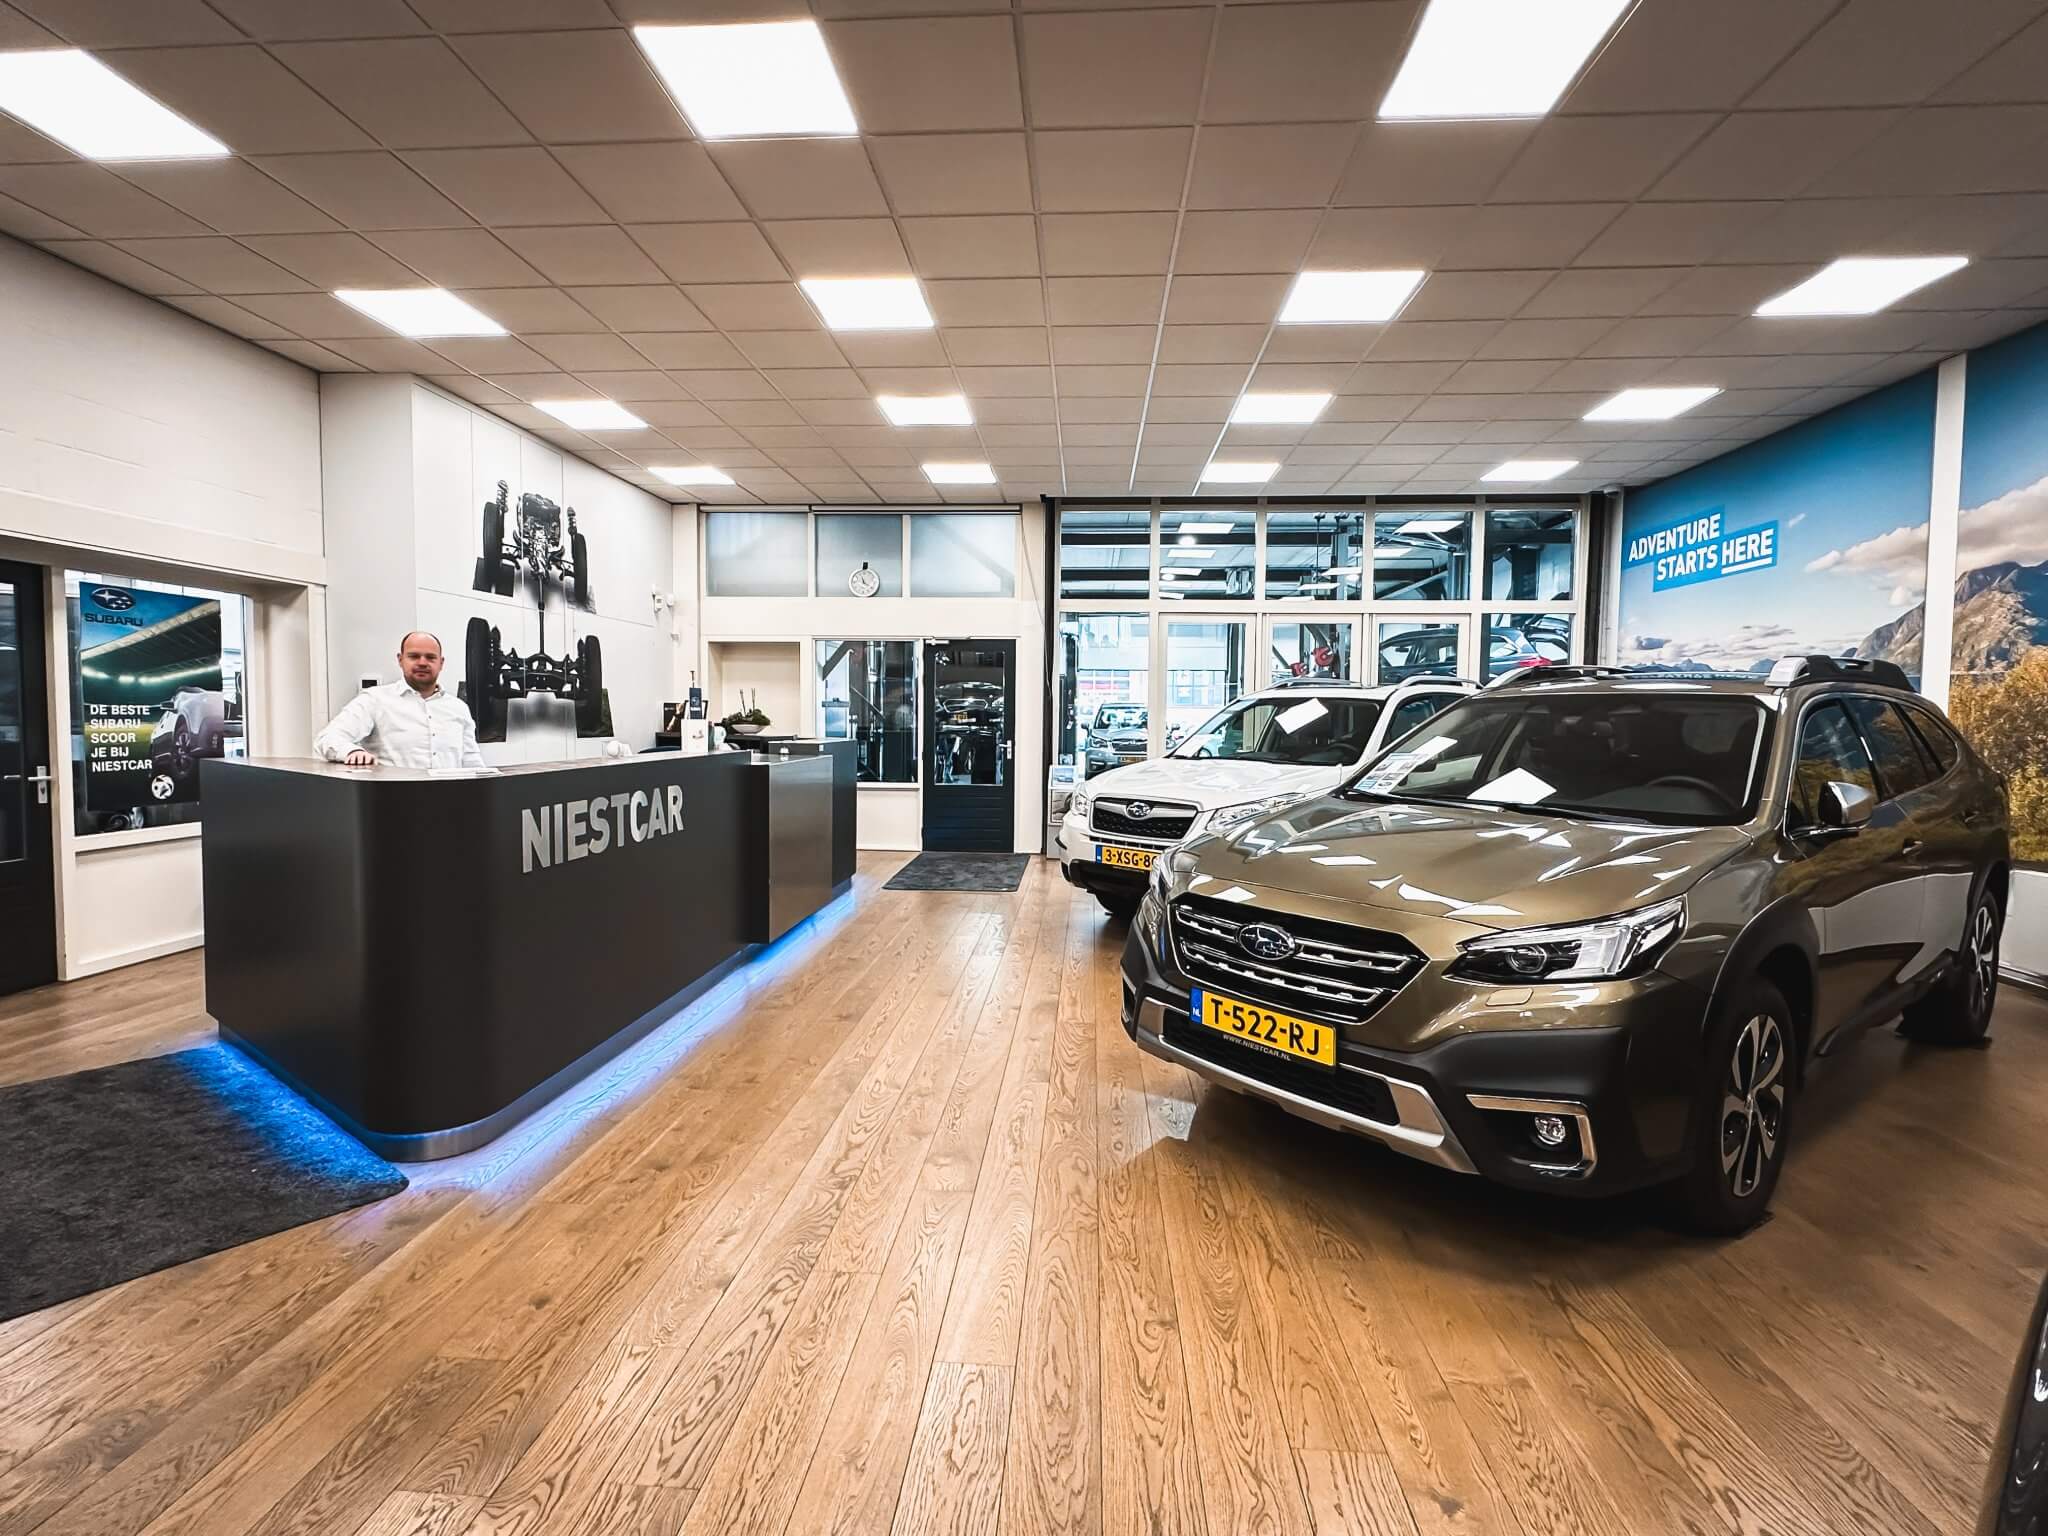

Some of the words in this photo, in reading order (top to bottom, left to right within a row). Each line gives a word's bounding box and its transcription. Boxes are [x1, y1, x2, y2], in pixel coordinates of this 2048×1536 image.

[1629, 513, 1721, 562] ADVENTURE
[1656, 545, 1718, 581] STARTS
[1721, 529, 1774, 565] HERE
[84, 613, 144, 627] SUBARU
[90, 704, 108, 716] DE
[111, 704, 151, 716] BESTE
[90, 718, 141, 730] SUBARU
[90, 732, 137, 744] SCOOR
[90, 747, 107, 758] JE
[110, 746, 129, 757] BIJ
[92, 759, 153, 773] NIESTCAR
[521, 784, 684, 873] NIESTCAR
[1192, 1007, 1201, 1017] NL
[1210, 998, 1320, 1056] T-522-RJ
